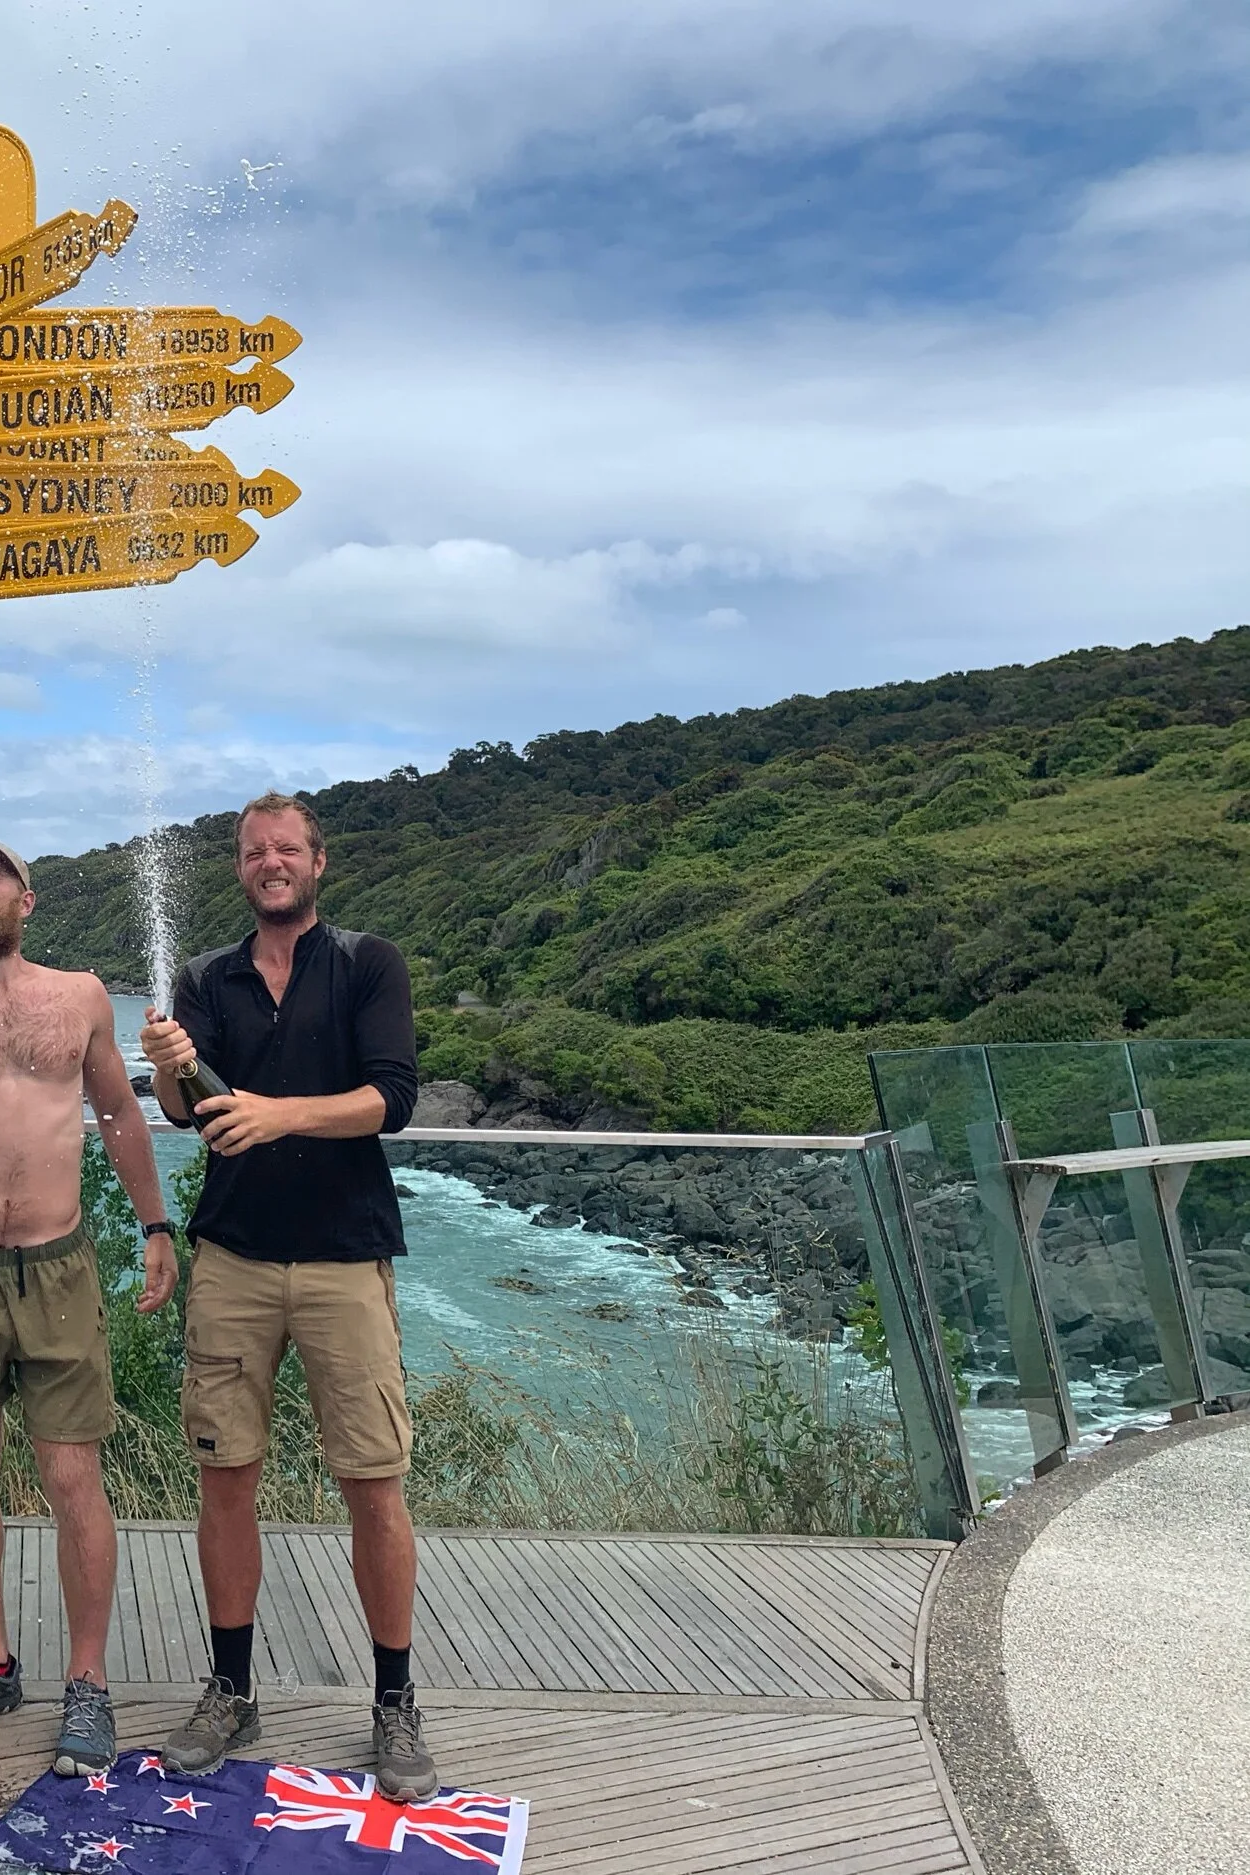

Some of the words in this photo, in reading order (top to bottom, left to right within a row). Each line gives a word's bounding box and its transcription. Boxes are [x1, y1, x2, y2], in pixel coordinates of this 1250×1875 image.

[156, 328, 229, 354] 18958
[240, 327, 274, 353] km
[225, 379, 261, 405] km
[169, 482, 229, 508] 2000
[238, 480, 273, 507] km
[194, 529, 229, 556] km
